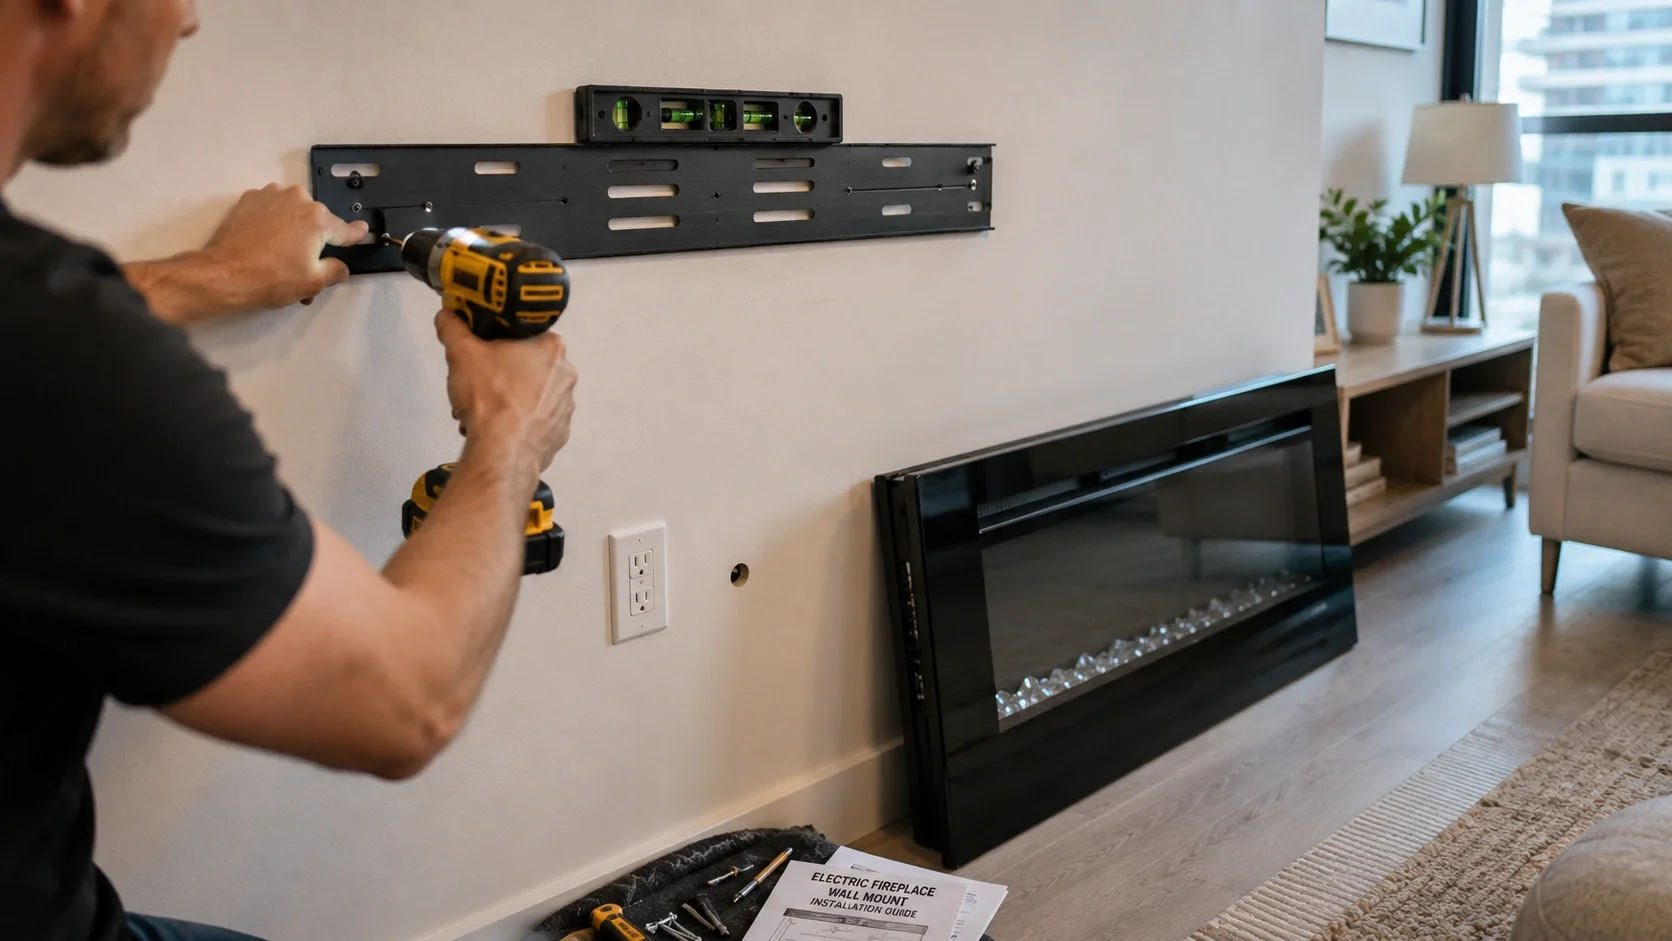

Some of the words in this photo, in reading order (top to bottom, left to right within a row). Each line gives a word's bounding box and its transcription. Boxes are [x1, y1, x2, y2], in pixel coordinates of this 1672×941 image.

[811, 872, 869, 888] ELECTRIC
[871, 880, 936, 897] FIREPLACE
[810, 898, 882, 914] INSTALLATION
[828, 887, 859, 900] WALL
[863, 892, 908, 906] MOUNT
